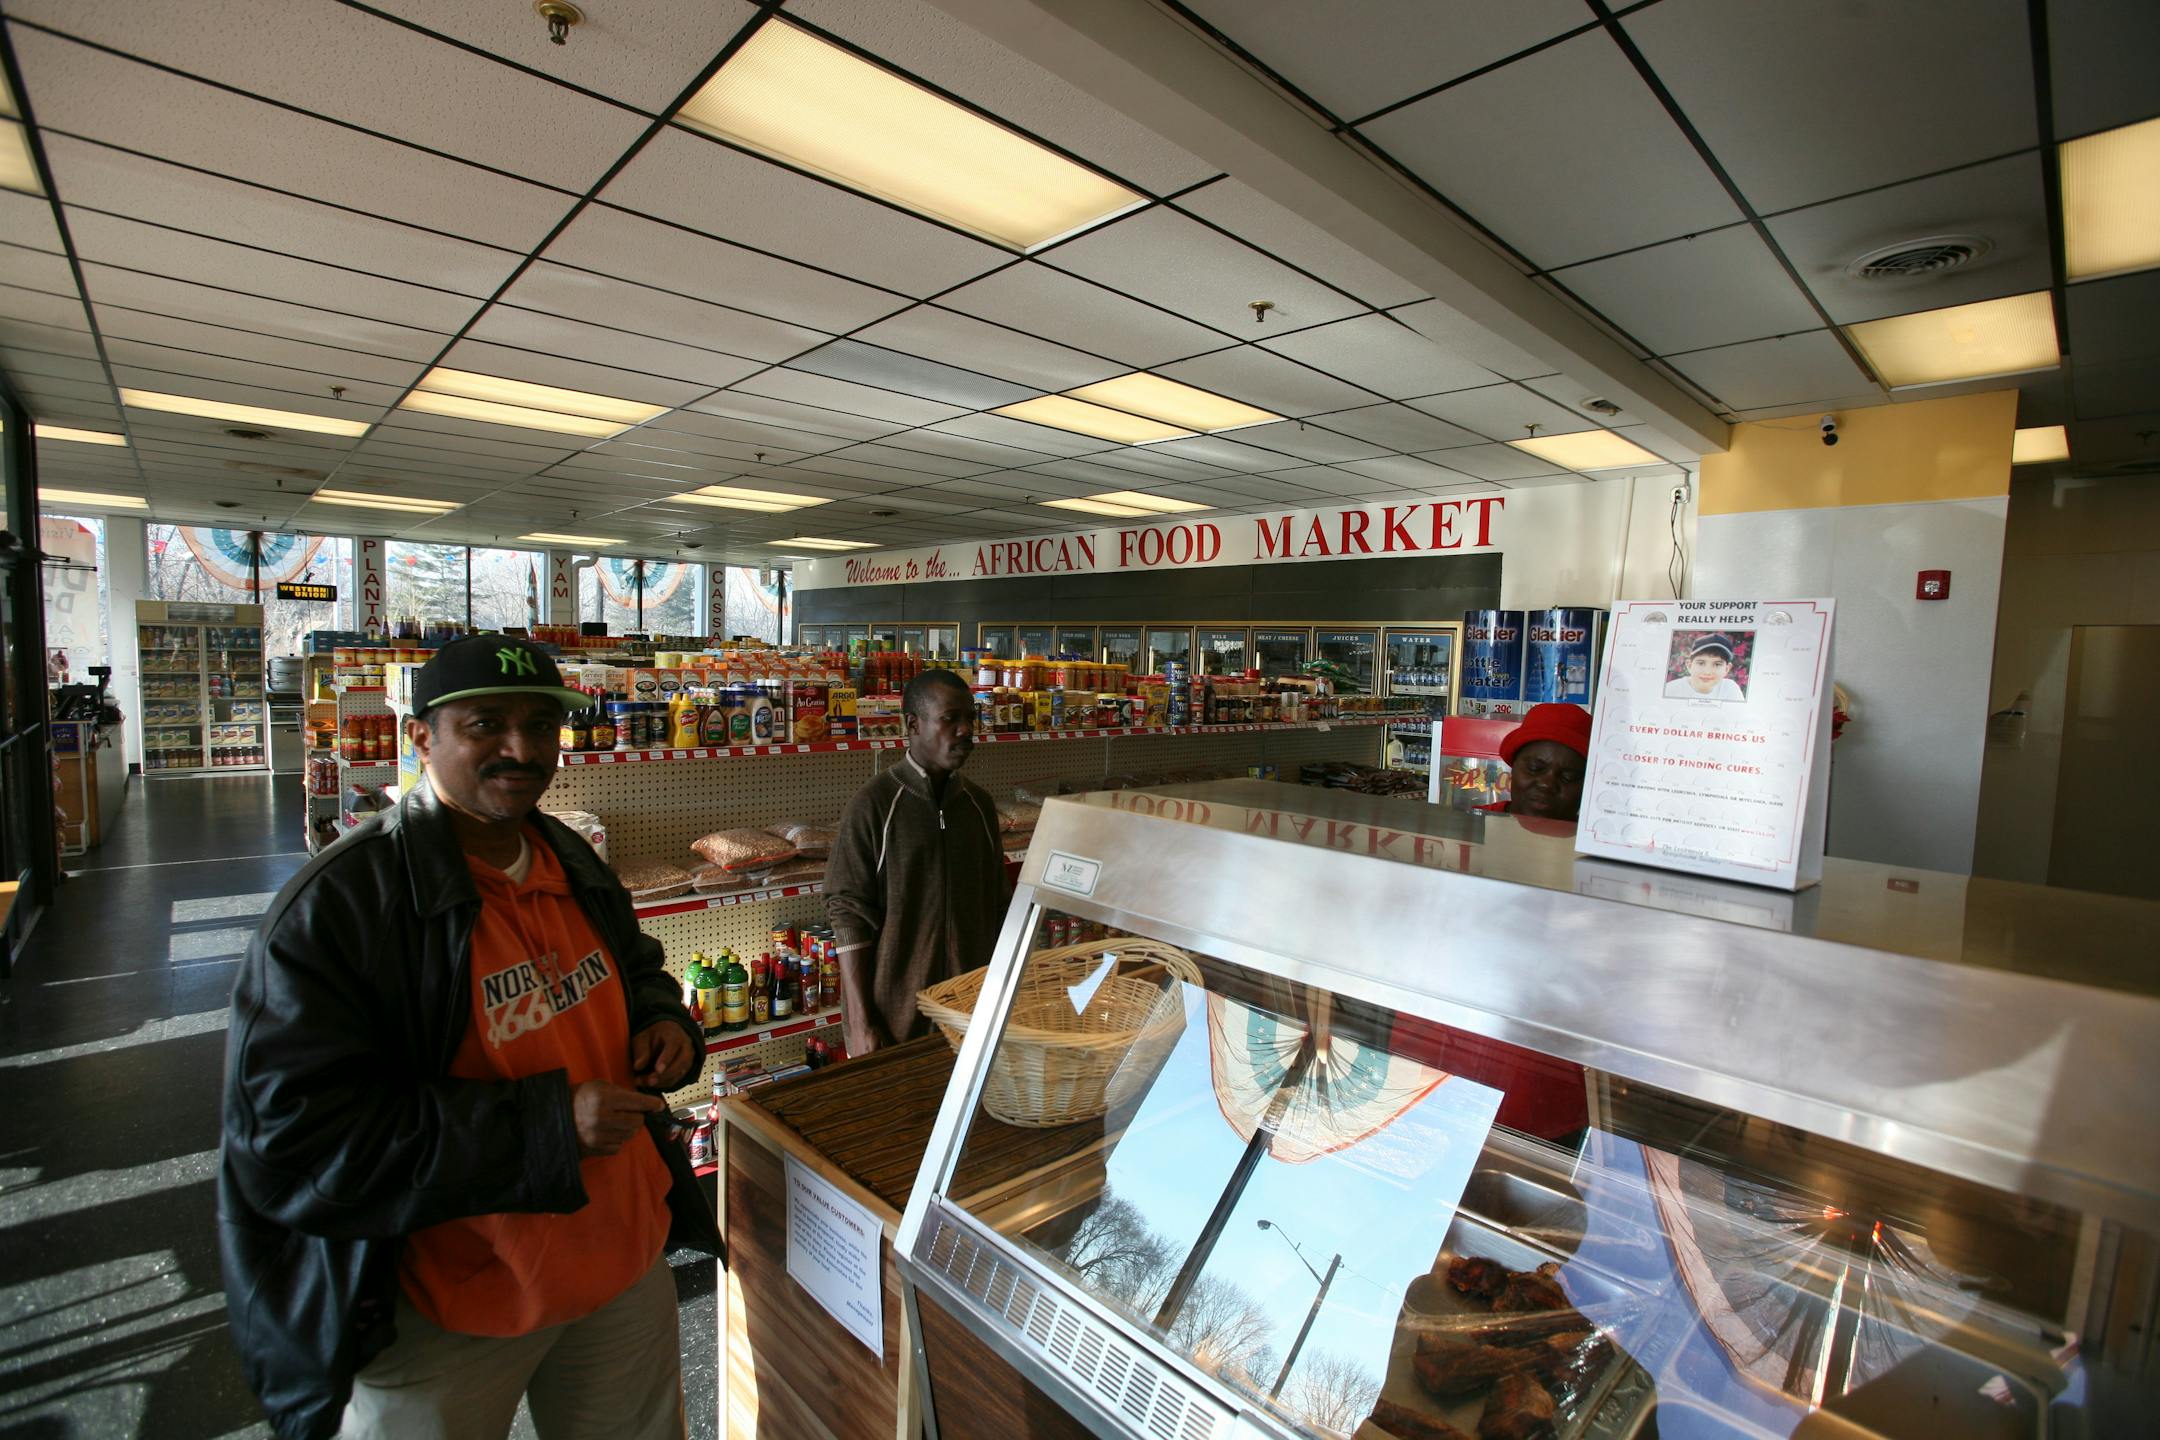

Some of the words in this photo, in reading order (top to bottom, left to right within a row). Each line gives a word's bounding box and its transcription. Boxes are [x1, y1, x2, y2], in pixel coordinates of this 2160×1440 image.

[846, 558, 901, 584] Welcome
[906, 558, 919, 580] to
[971, 534, 1096, 576] AFRICAN
[1118, 523, 1221, 567] FOOD
[1253, 497, 1505, 559] MARKET
[553, 558, 568, 598] YAM
[280, 585, 326, 593] WESTERN
[1679, 601, 1706, 610] YOUR
[1709, 601, 1758, 610] SUPPORT
[1677, 615, 1716, 624] REALLY
[1719, 615, 1754, 624] HELPS
[832, 692, 855, 700] ARGO
[1629, 725, 1660, 735] EVERY
[1663, 728, 1703, 738] DOLLAR
[1707, 731, 1748, 742] BRINGS
[1622, 753, 1659, 764] CLOSER
[1663, 757, 1675, 766] TO
[1679, 760, 1722, 771] FINDING
[1727, 764, 1764, 775] CURES.
[813, 1192, 830, 1210] VALUE
